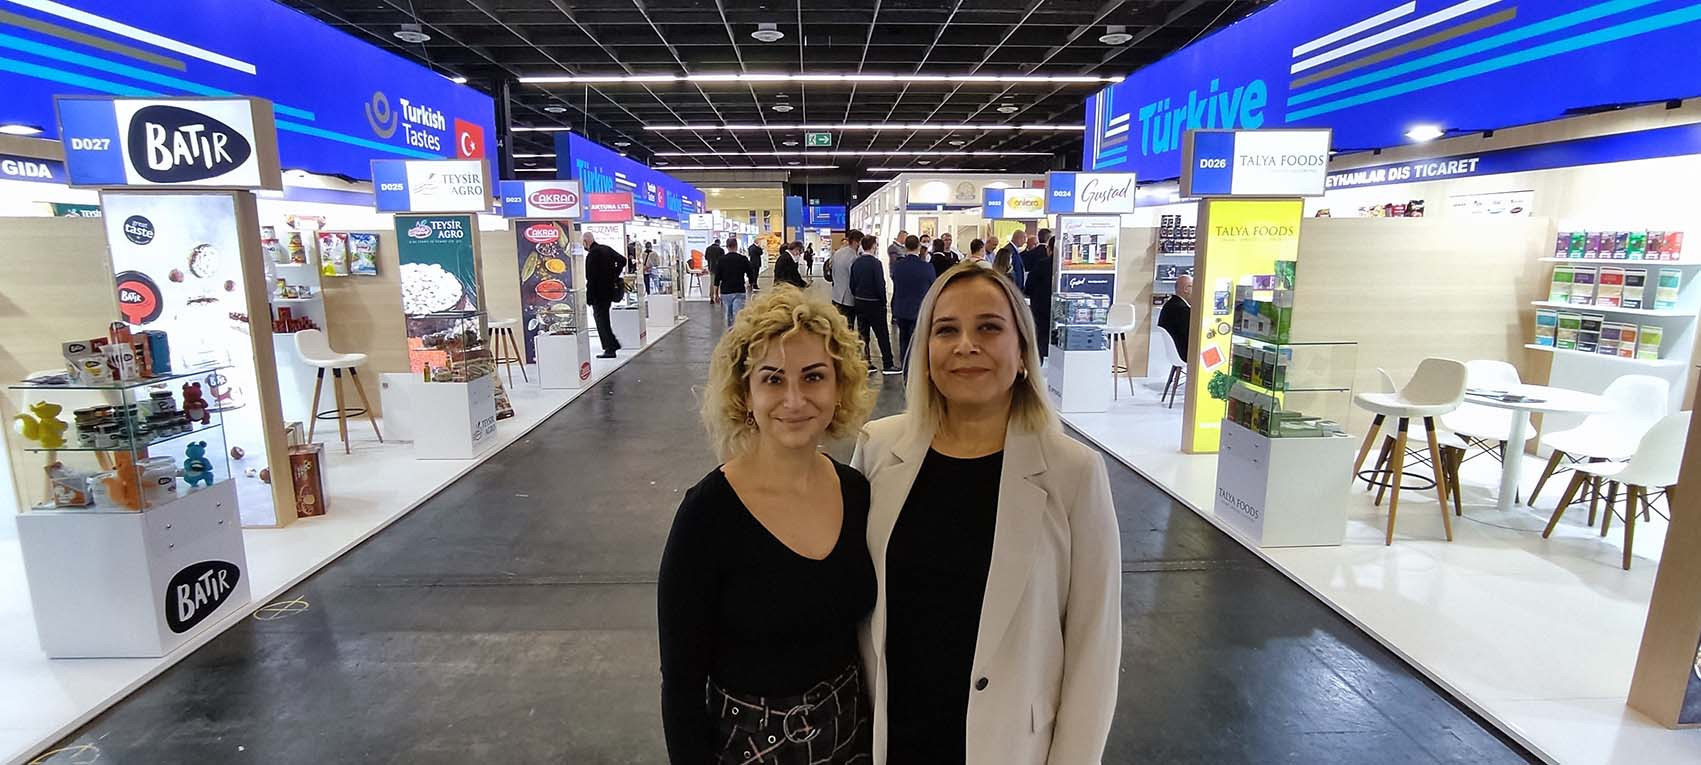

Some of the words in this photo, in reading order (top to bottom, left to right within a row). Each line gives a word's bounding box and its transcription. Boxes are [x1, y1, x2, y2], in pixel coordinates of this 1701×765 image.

[400, 98, 446, 131] Turkish
[1139, 78, 1268, 157] Türkiye
[71, 138, 111, 151] D027
[402, 122, 441, 151] Tastes
[145, 122, 233, 171] BATIR
[1199, 158, 1227, 169] D026
[1240, 154, 1276, 167] TALYA
[1281, 154, 1325, 167] FOODS
[1, 160, 53, 179] GIDA
[1325, 169, 1386, 188] EYHANLAR
[1388, 166, 1411, 181] DIS
[1414, 157, 1480, 178] TICARET
[380, 183, 404, 192] D025
[451, 185, 483, 196] AGRO
[1053, 190, 1072, 198] D024
[1081, 178, 1132, 213] Gustad
[125, 223, 154, 239] taste
[437, 230, 464, 239] AGRO
[1215, 225, 1250, 237] TALYA
[1253, 225, 1295, 237] FOODS
[1218, 487, 1236, 506] TALYA
[1236, 498, 1259, 520] FOODS
[176, 569, 231, 622] BATIR
